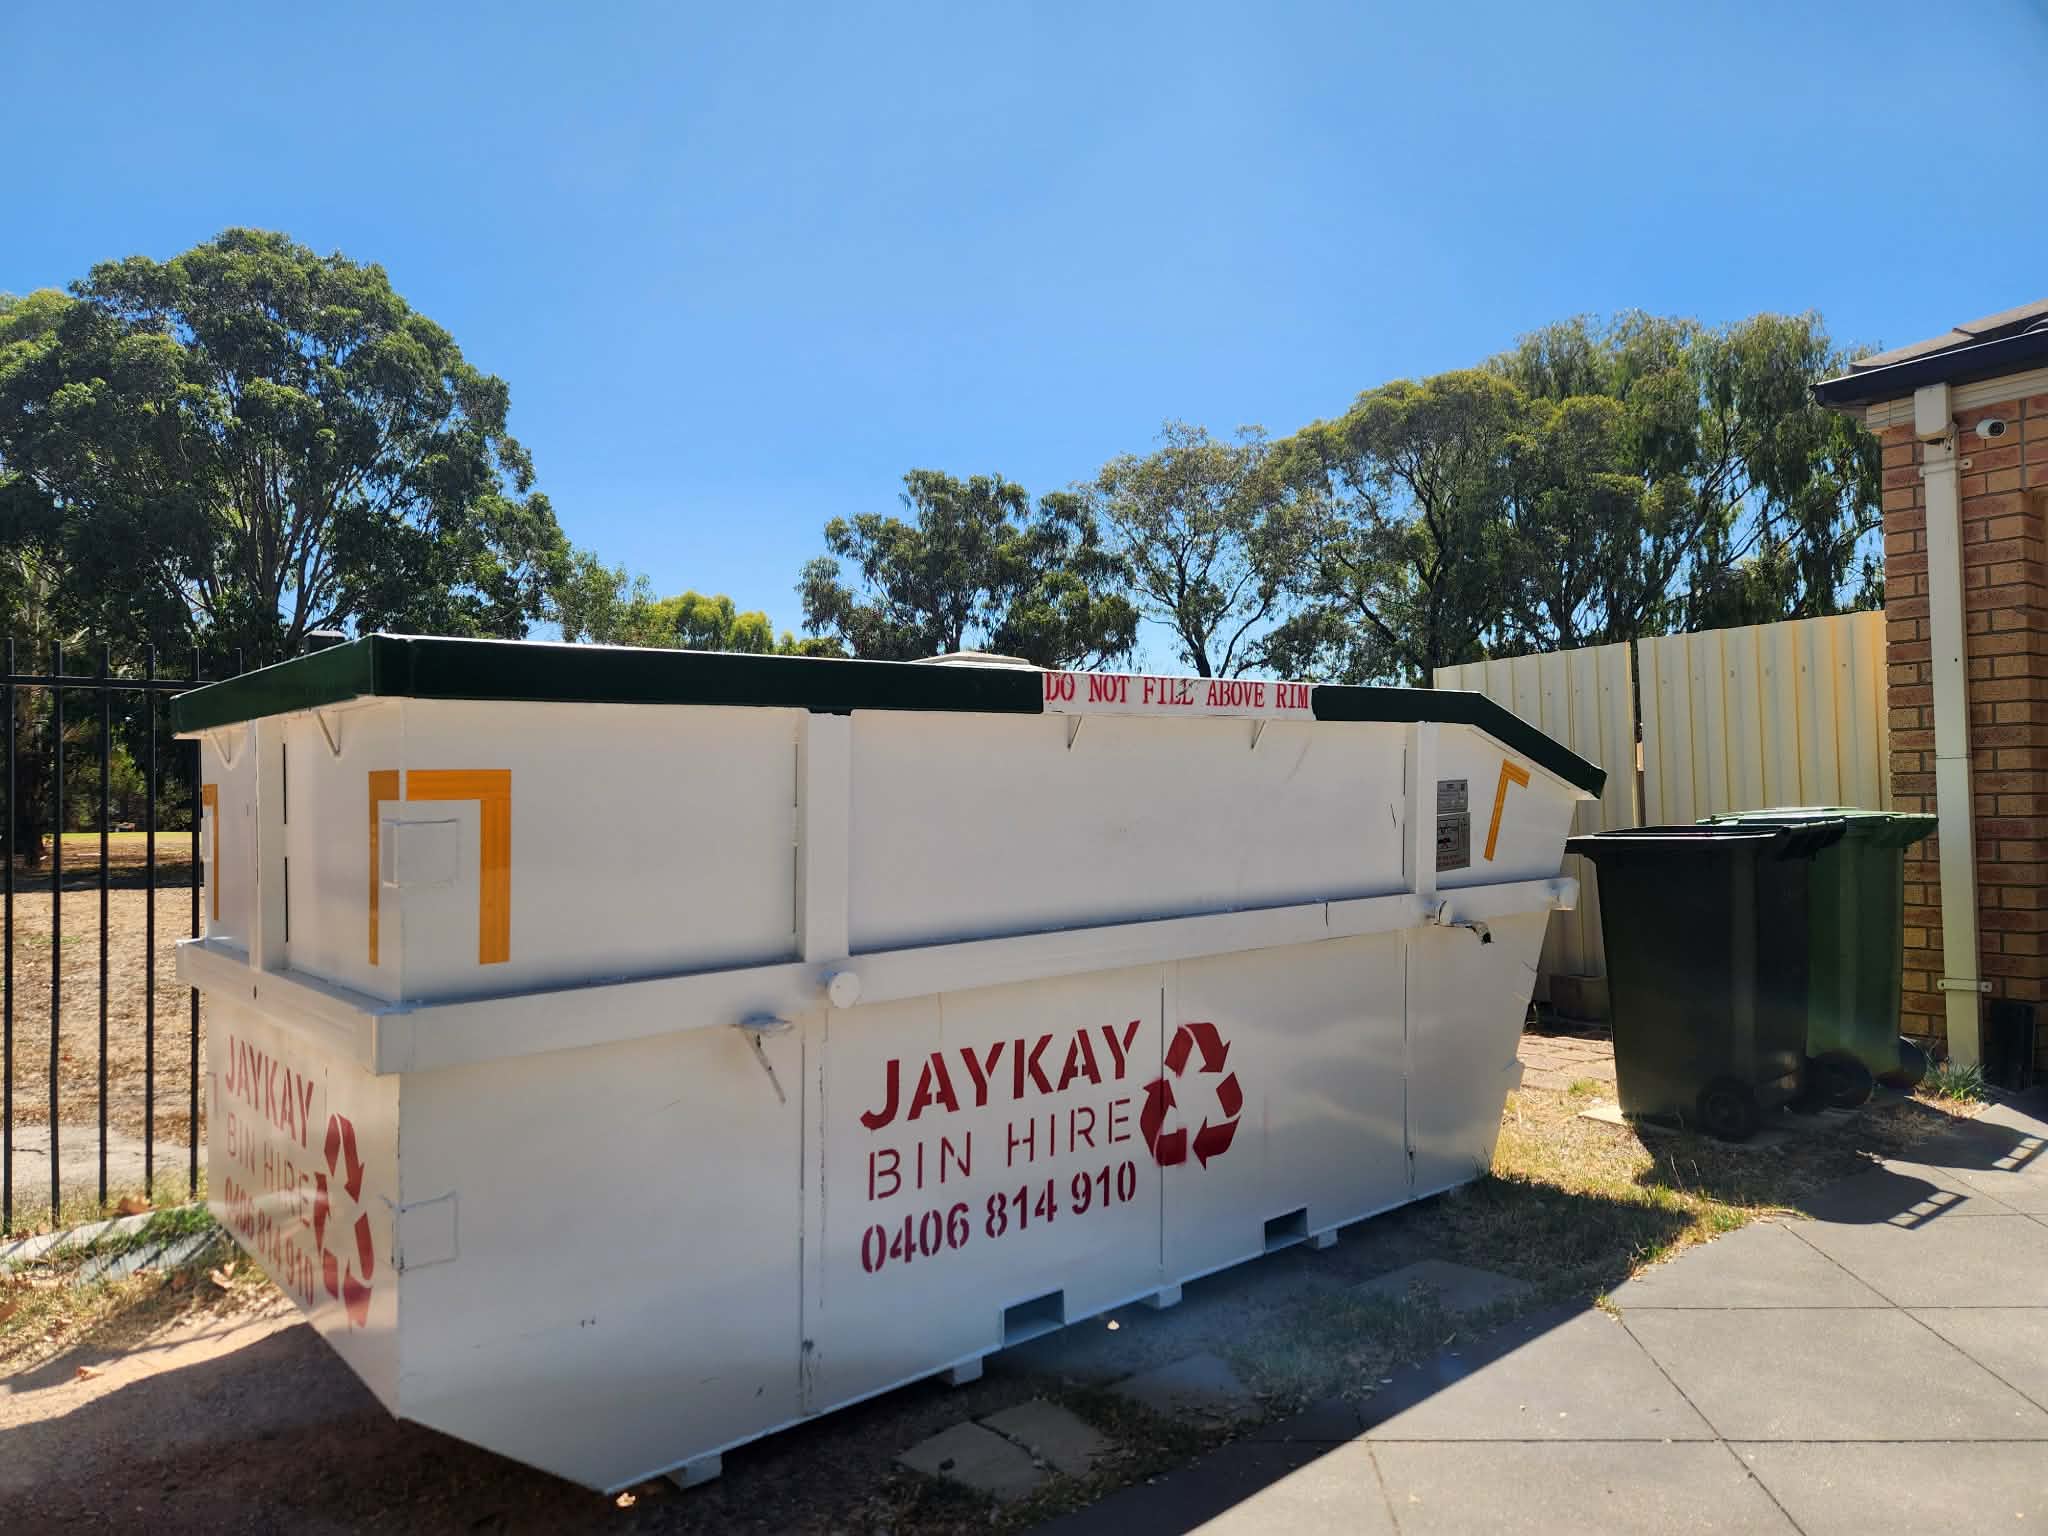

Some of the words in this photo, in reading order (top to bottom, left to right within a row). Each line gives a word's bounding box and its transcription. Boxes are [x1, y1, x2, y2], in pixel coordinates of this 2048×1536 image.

[1045, 672, 1075, 701] DO
[1088, 675, 1130, 703] NOT
[1143, 677, 1194, 705] FILL
[1206, 680, 1265, 707] ABOVE
[1276, 685, 1309, 709] RIM
[226, 1034, 314, 1148] JAYKAY
[860, 1020, 1141, 1131] JAYKAY
[227, 1111, 256, 1176] BIN
[868, 1131, 971, 1200] BIN
[1007, 1098, 1131, 1167] HIRE
[861, 1202, 970, 1273] 0406
[985, 1179, 1058, 1239] 814
[1071, 1160, 1137, 1216] 910
